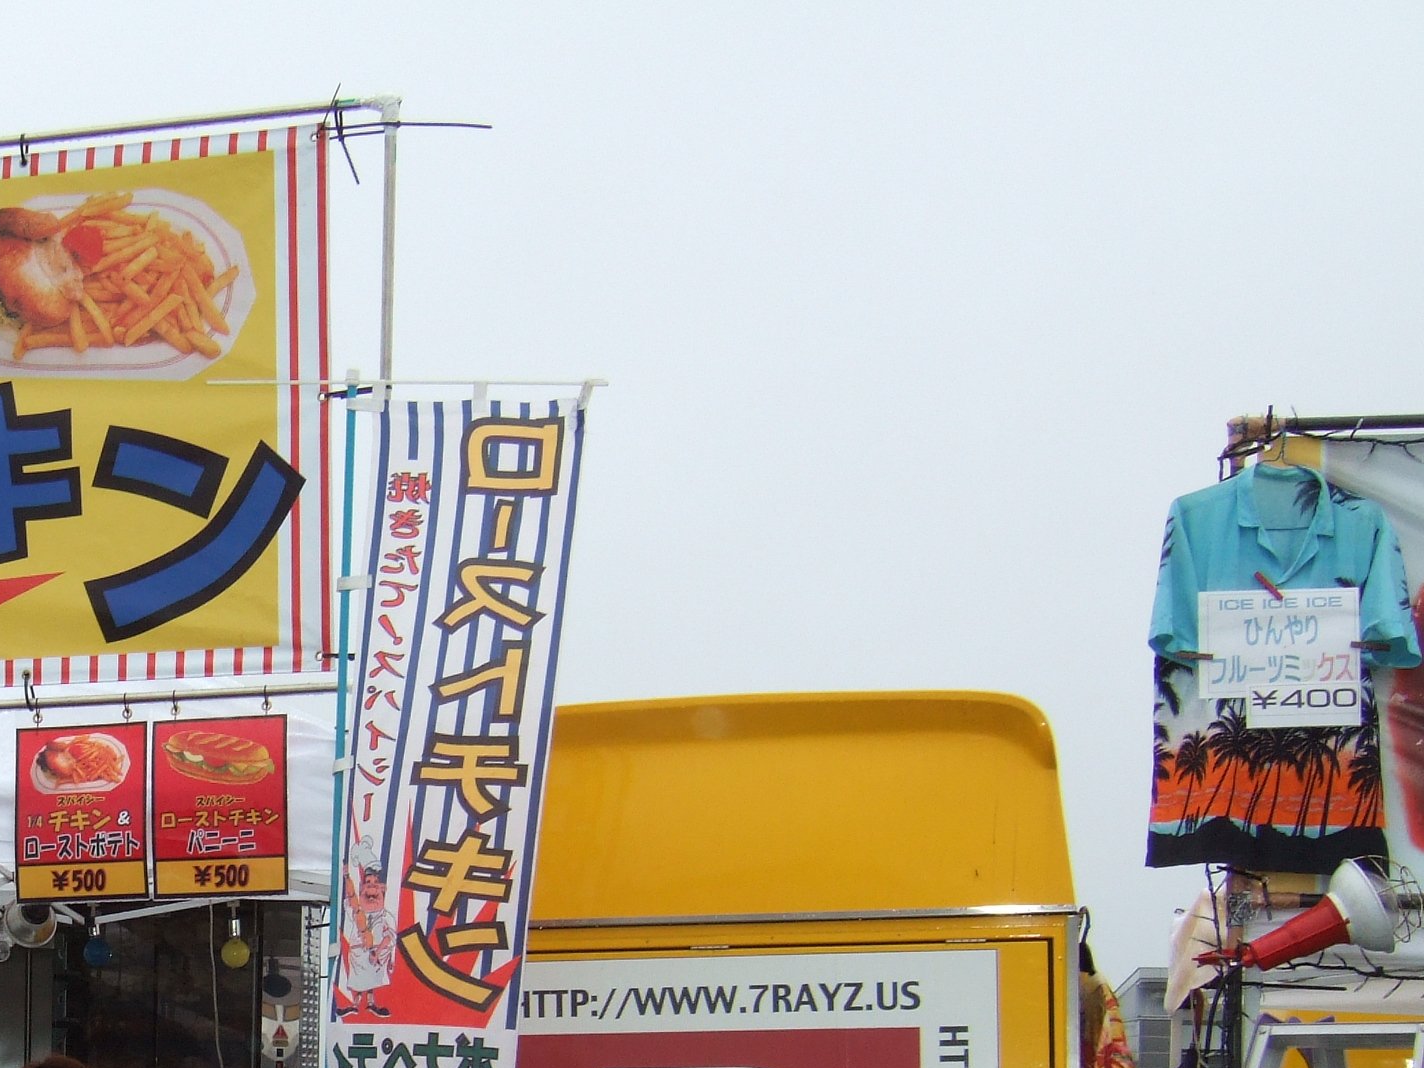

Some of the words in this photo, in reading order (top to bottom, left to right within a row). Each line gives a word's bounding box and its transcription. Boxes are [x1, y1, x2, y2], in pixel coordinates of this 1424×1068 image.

[1219, 599, 1254, 610] ICE
[1263, 597, 1298, 609] ICE
[1307, 596, 1342, 608] ICE
[1244, 615, 1318, 645] ひんやり
[1211, 652, 1354, 684] フルーツミックス
[1252, 688, 1357, 709] ¥400
[196, 795, 246, 806] スパイシー
[48, 809, 112, 832] チキン
[117, 811, 130, 825] &
[161, 808, 279, 828] ローストチキン
[24, 831, 140, 861] ローストポテト
[186, 828, 256, 854] パニーニ
[51, 869, 106, 891] ¥500
[193, 864, 249, 887] ¥500
